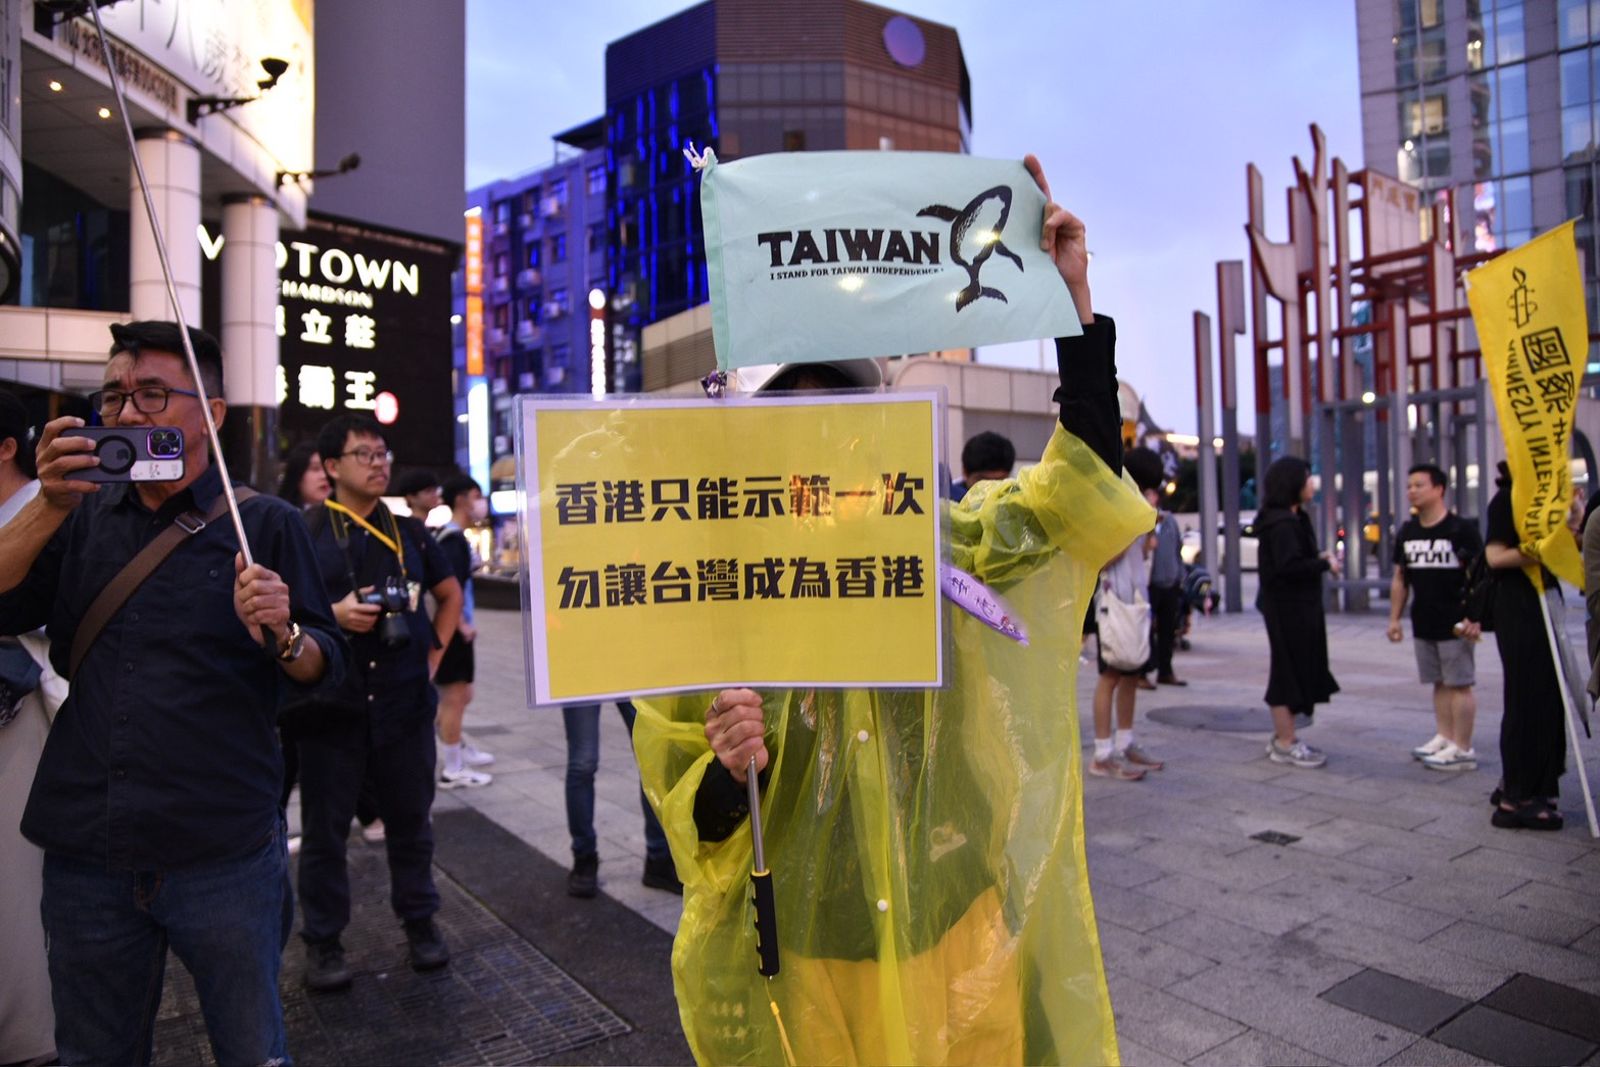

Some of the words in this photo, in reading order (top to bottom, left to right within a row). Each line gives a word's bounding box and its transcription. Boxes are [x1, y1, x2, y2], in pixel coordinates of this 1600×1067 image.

[757, 228, 942, 267] TAIWAN
[770, 272, 775, 280] I
[777, 270, 808, 280] STAND
[811, 268, 829, 277] FOR
[831, 266, 869, 275] TAIWAN
[554, 471, 925, 526] 香港只能示範一次
[557, 555, 925, 610] 勿讓台灣成為香港
